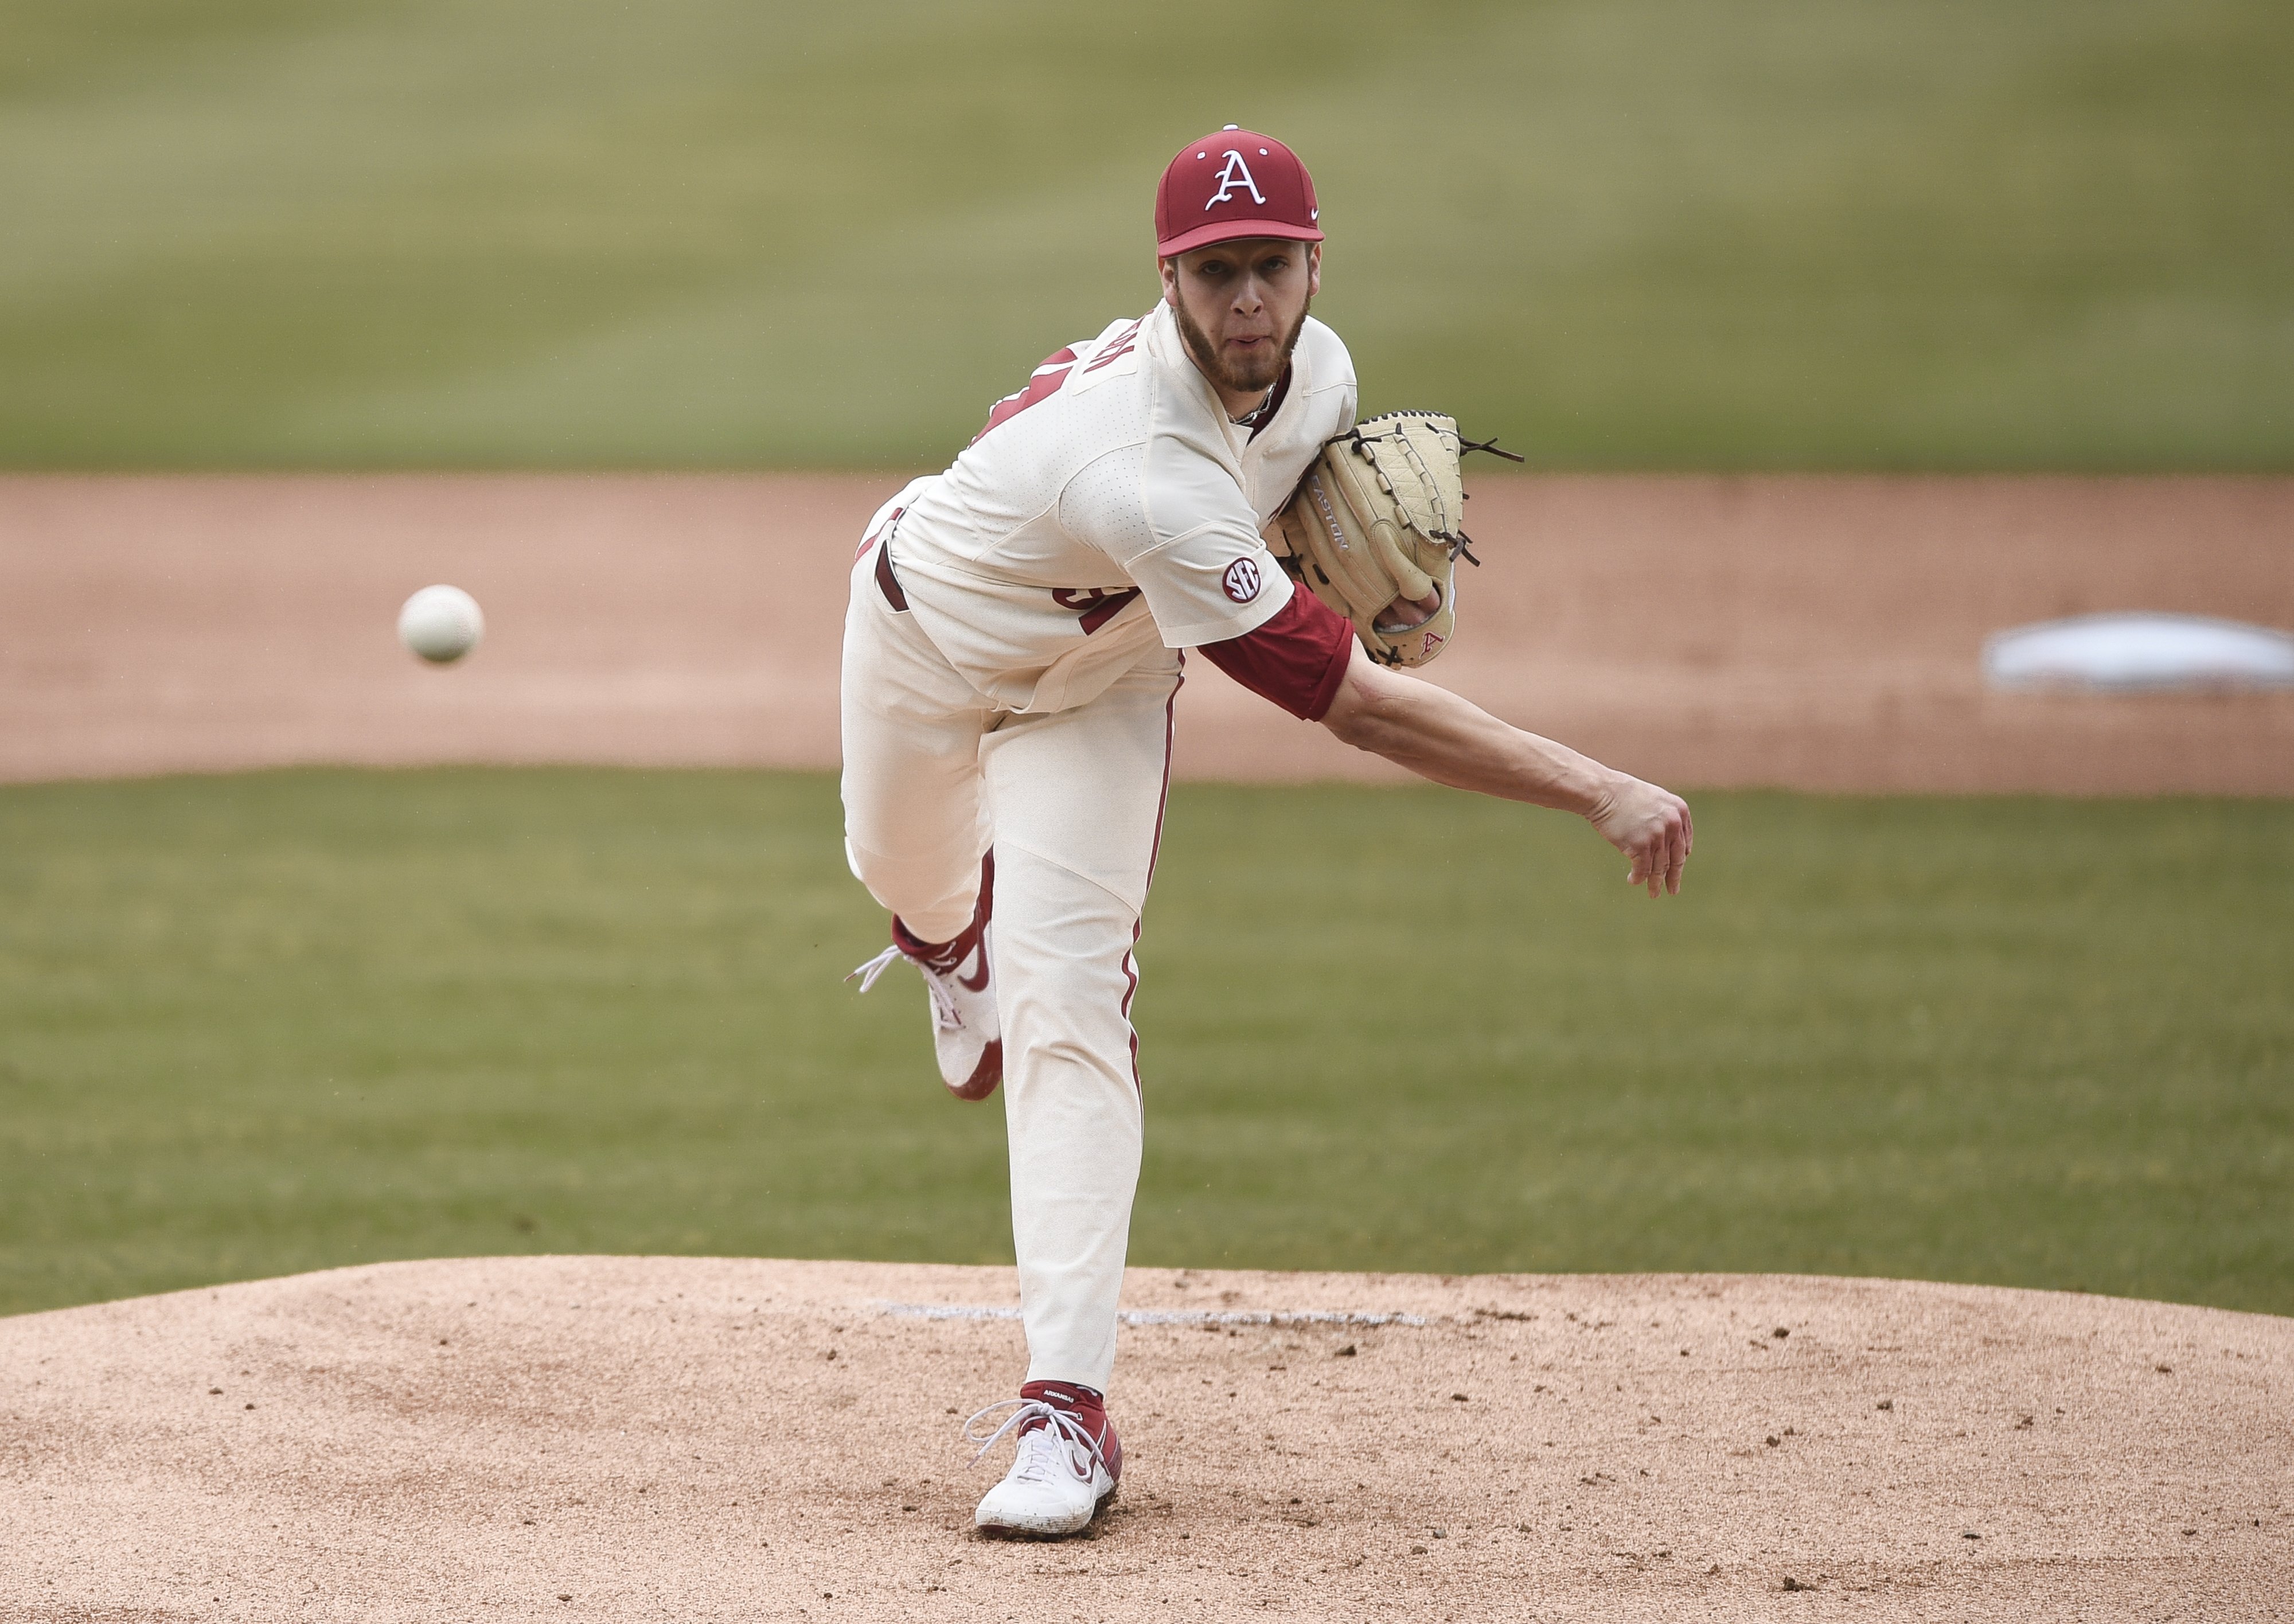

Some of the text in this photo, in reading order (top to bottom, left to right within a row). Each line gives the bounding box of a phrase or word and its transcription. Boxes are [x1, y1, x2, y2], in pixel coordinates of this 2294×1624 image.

[1204, 149, 1266, 211] A
[1311, 474, 1349, 550] EASTON
[1226, 560, 1259, 600] SEC
[1419, 631, 1445, 659] A
